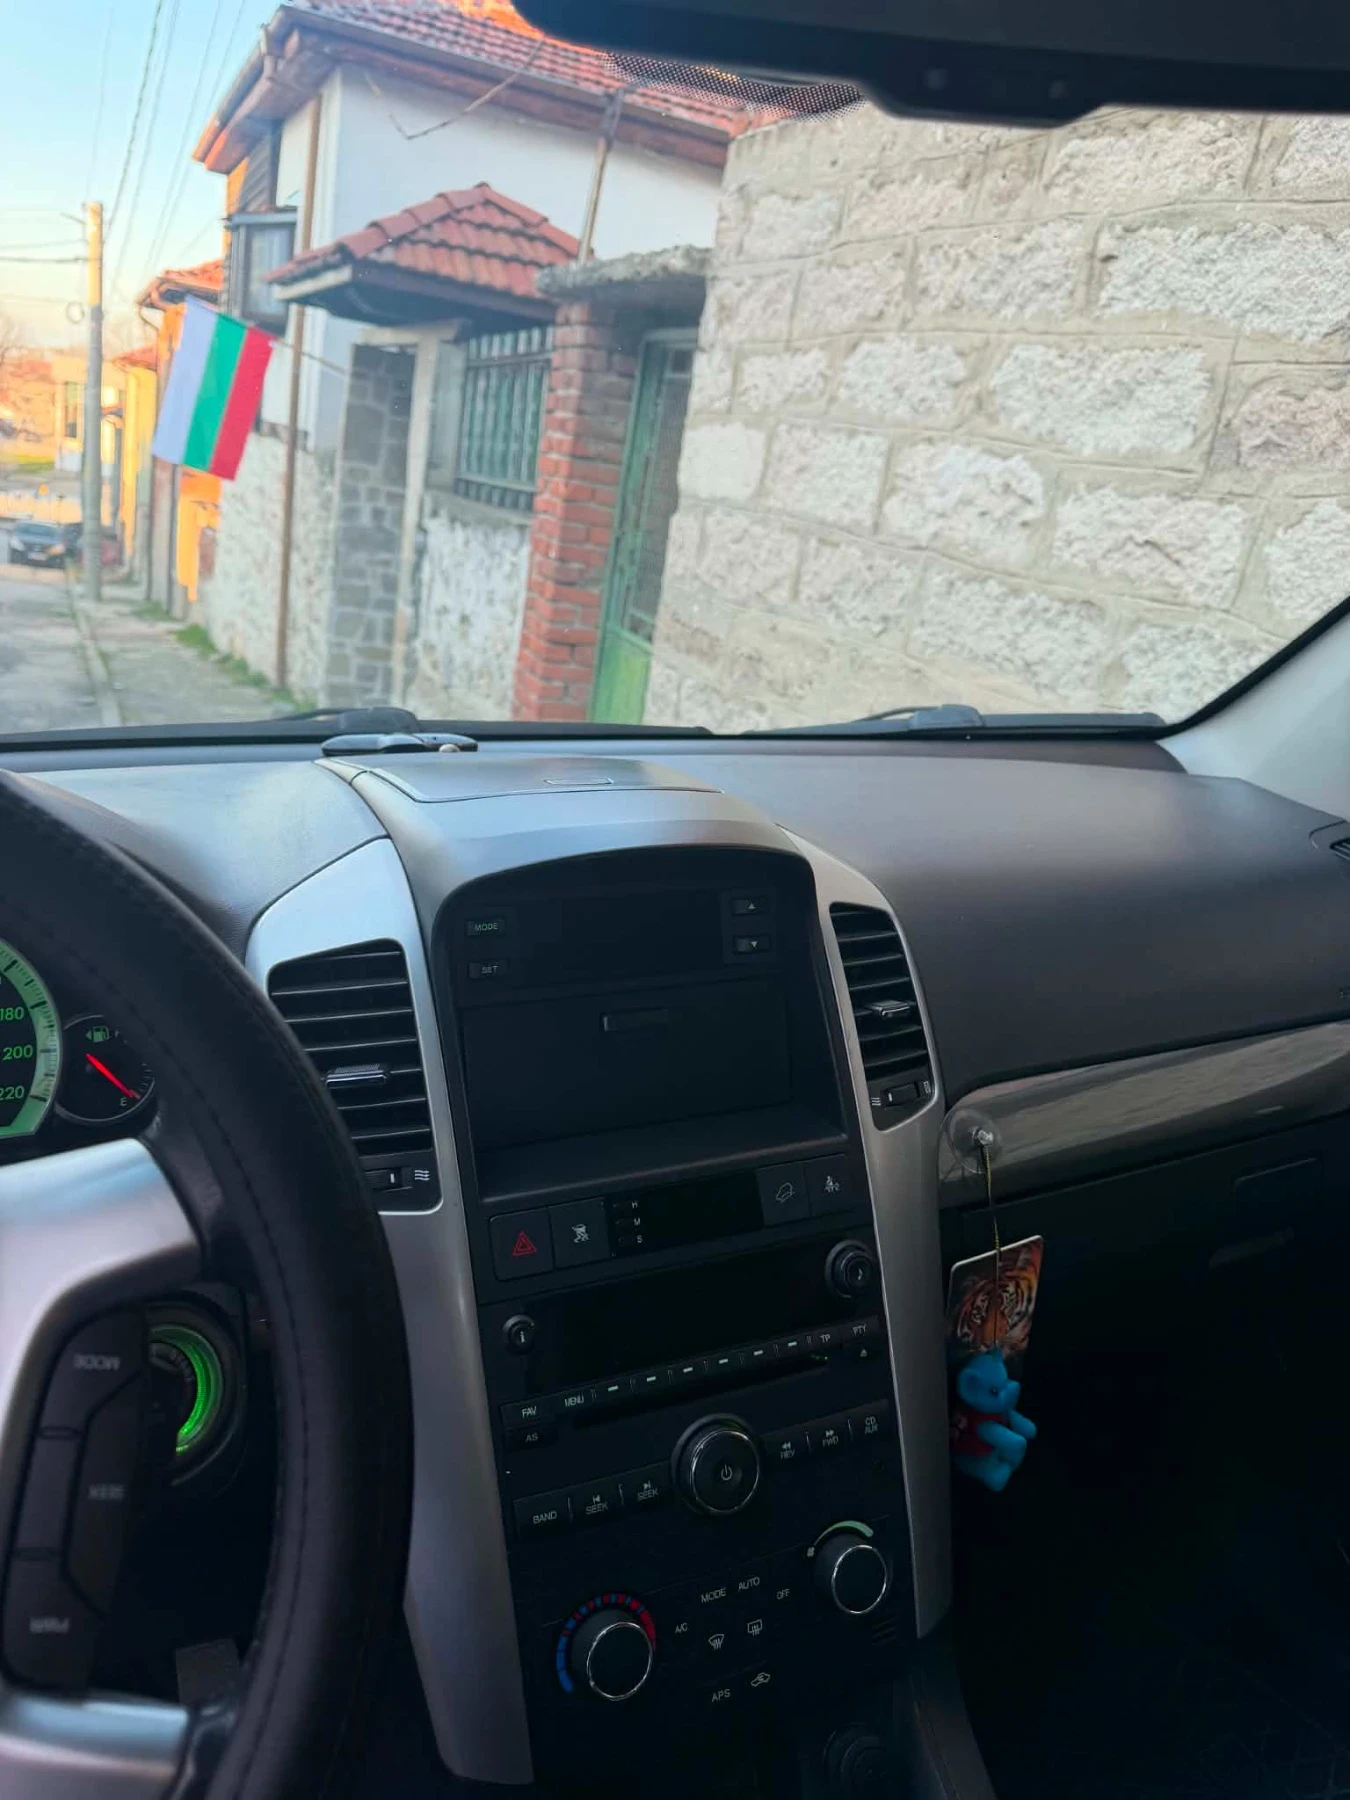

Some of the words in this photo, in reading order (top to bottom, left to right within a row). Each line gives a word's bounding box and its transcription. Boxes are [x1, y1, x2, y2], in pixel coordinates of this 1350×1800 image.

[474, 922, 499, 931] MODE
[481, 965, 499, 975] SET
[0, 1006, 24, 1020] 180
[3, 1044, 33, 1060] 200
[633, 1217, 641, 1226] M
[636, 1234, 644, 1244] S
[819, 1333, 831, 1343] TP
[564, 1392, 585, 1407] MENU
[521, 1405, 537, 1418] FAV
[525, 1432, 540, 1443] AS
[637, 1488, 659, 1502] SEEK
[585, 1501, 609, 1516] SEEK
[532, 1510, 558, 1525] BAND
[738, 1576, 761, 1592] AUTO
[700, 1587, 727, 1603] MODE
[776, 1588, 791, 1600] OFF
[674, 1622, 688, 1634] A/C
[711, 1689, 732, 1702] APS
